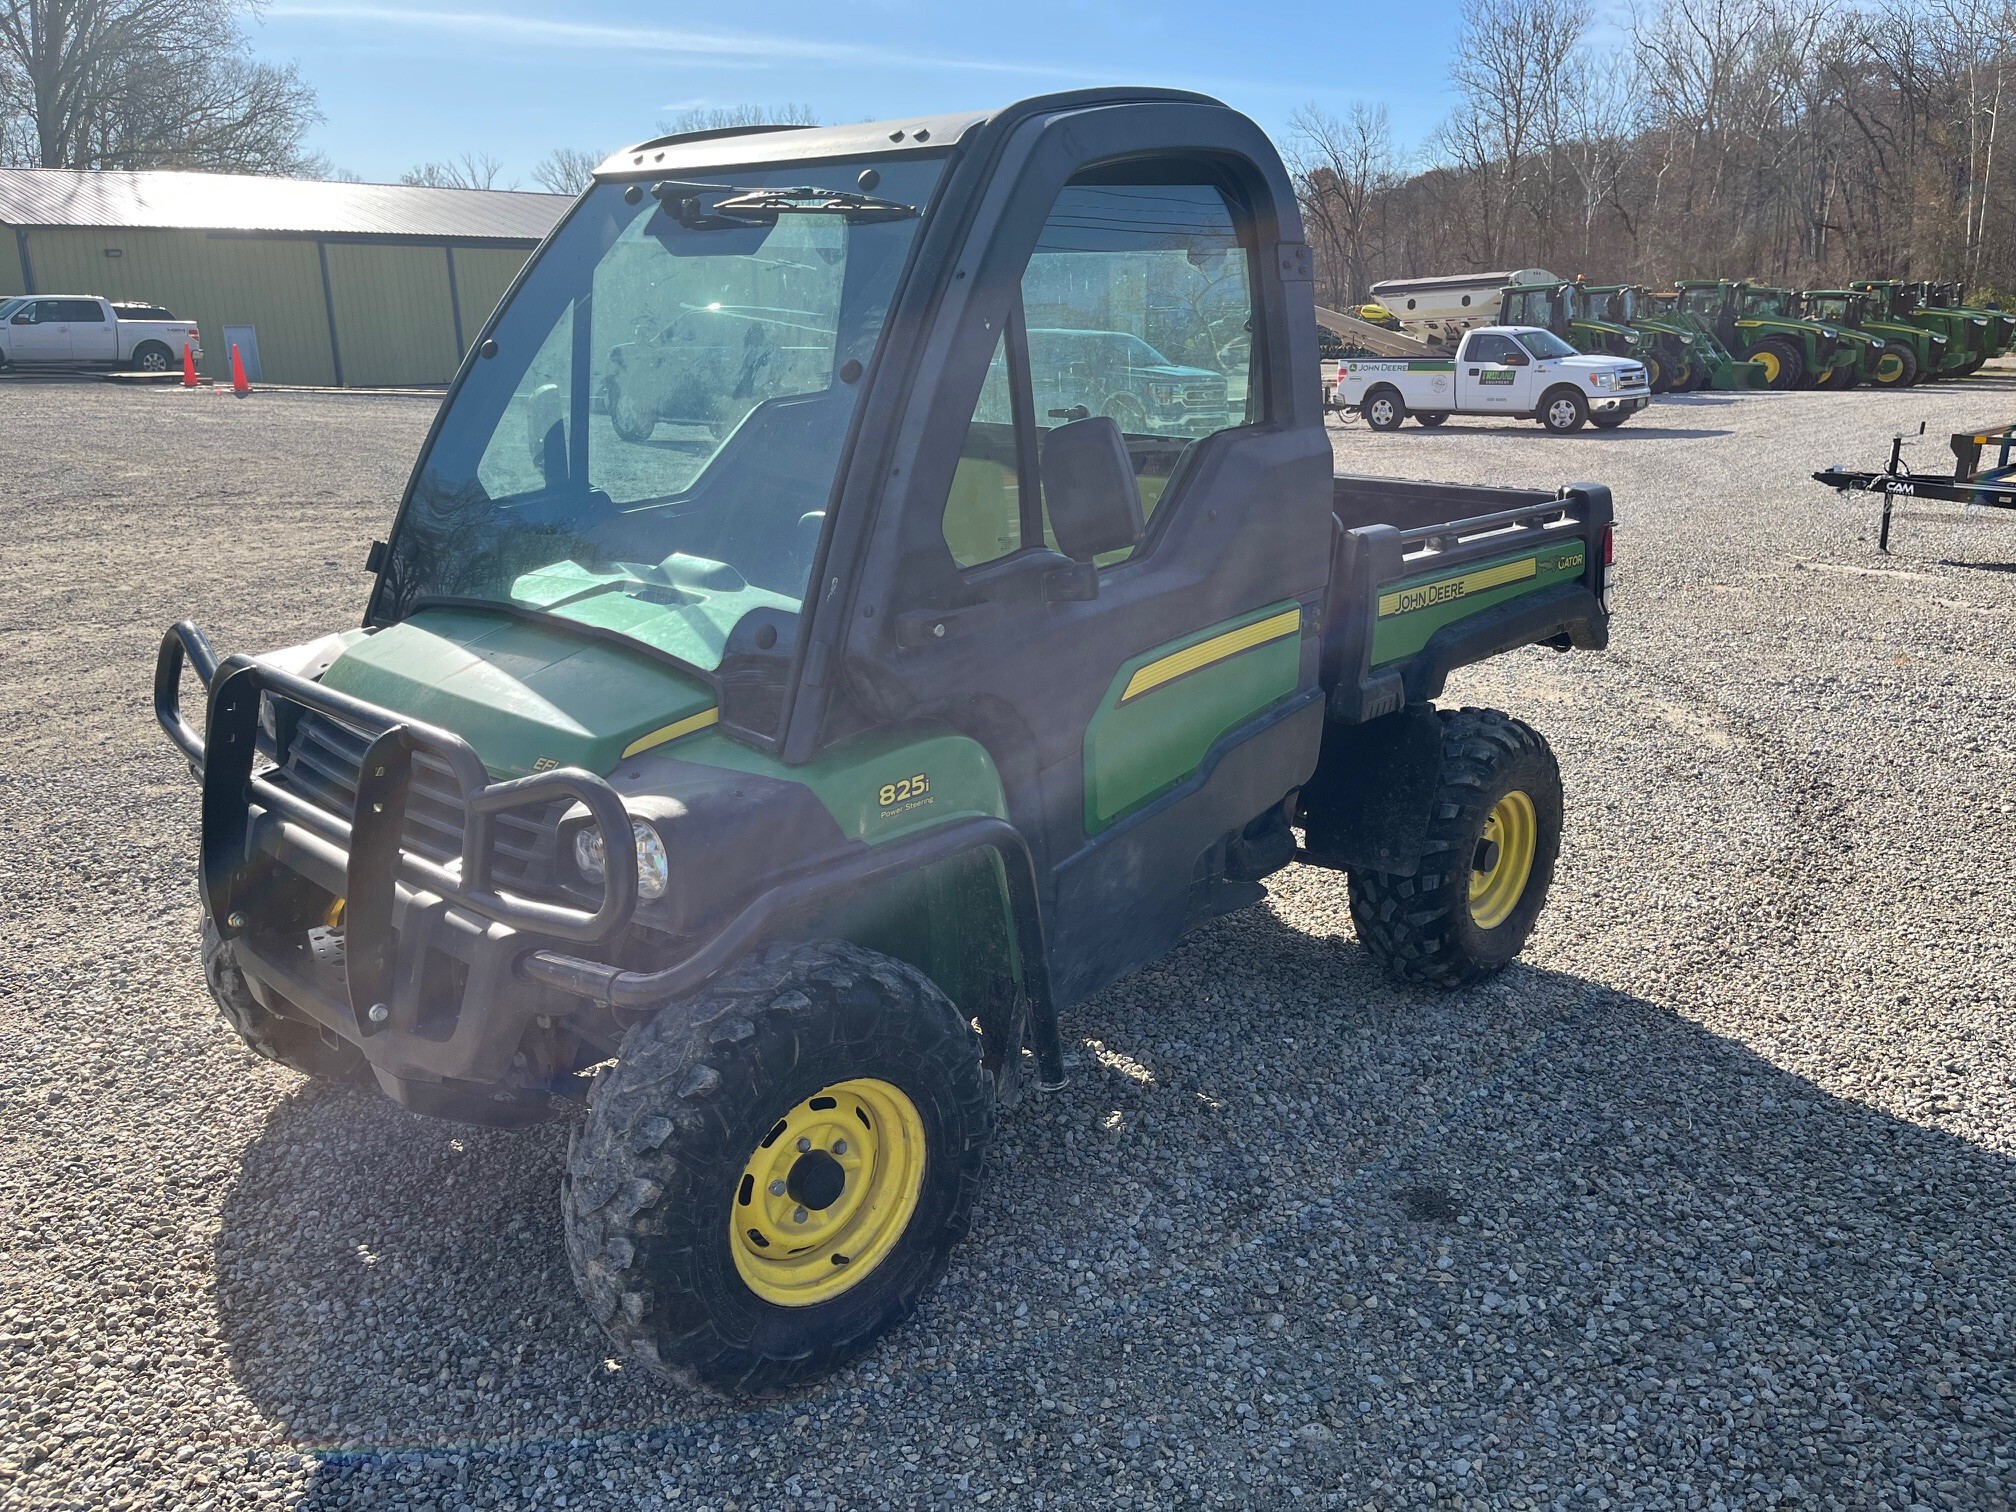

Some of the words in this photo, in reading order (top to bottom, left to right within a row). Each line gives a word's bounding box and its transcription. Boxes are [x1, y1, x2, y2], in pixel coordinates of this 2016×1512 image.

[1358, 364, 1380, 372] JOHN
[1381, 363, 1408, 372] DEERE
[1886, 482, 1915, 495] CAM
[1558, 554, 1583, 570] GATOR
[1395, 592, 1427, 613] JOHN
[1429, 581, 1465, 604] DEERE
[879, 773, 930, 806] 825i
[881, 806, 904, 819] Power
[905, 796, 934, 811] Steering
